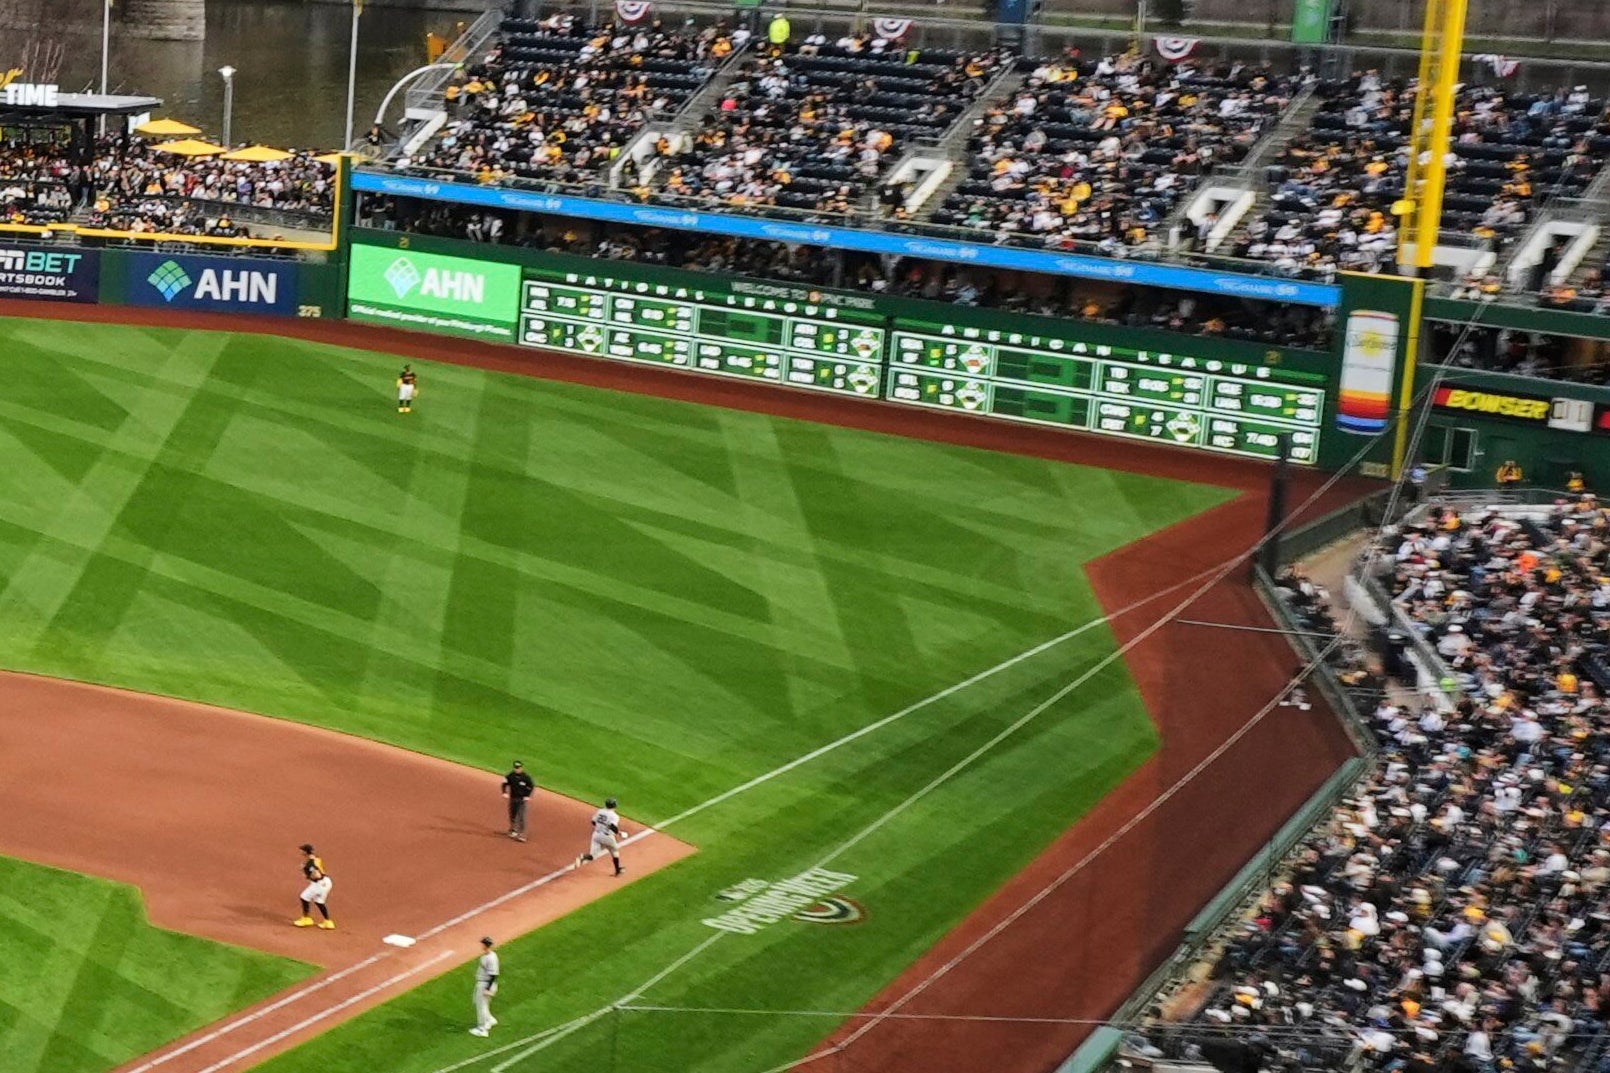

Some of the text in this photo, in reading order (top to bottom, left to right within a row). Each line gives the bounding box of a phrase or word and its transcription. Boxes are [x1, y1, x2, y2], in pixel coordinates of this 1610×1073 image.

[3, 82, 59, 107] TIME
[25, 250, 82, 274] BET
[194, 268, 278, 304] AHN
[420, 267, 486, 304] AHN
[566, 273, 704, 301] NATIONAL
[726, 295, 838, 319] LEAGUE
[298, 304, 321, 318] 375
[941, 324, 1112, 357] AMERICAN
[1138, 351, 1271, 379] LEAGUE
[1446, 388, 1550, 420] BOWSER
[701, 886, 816, 936] OPENING
